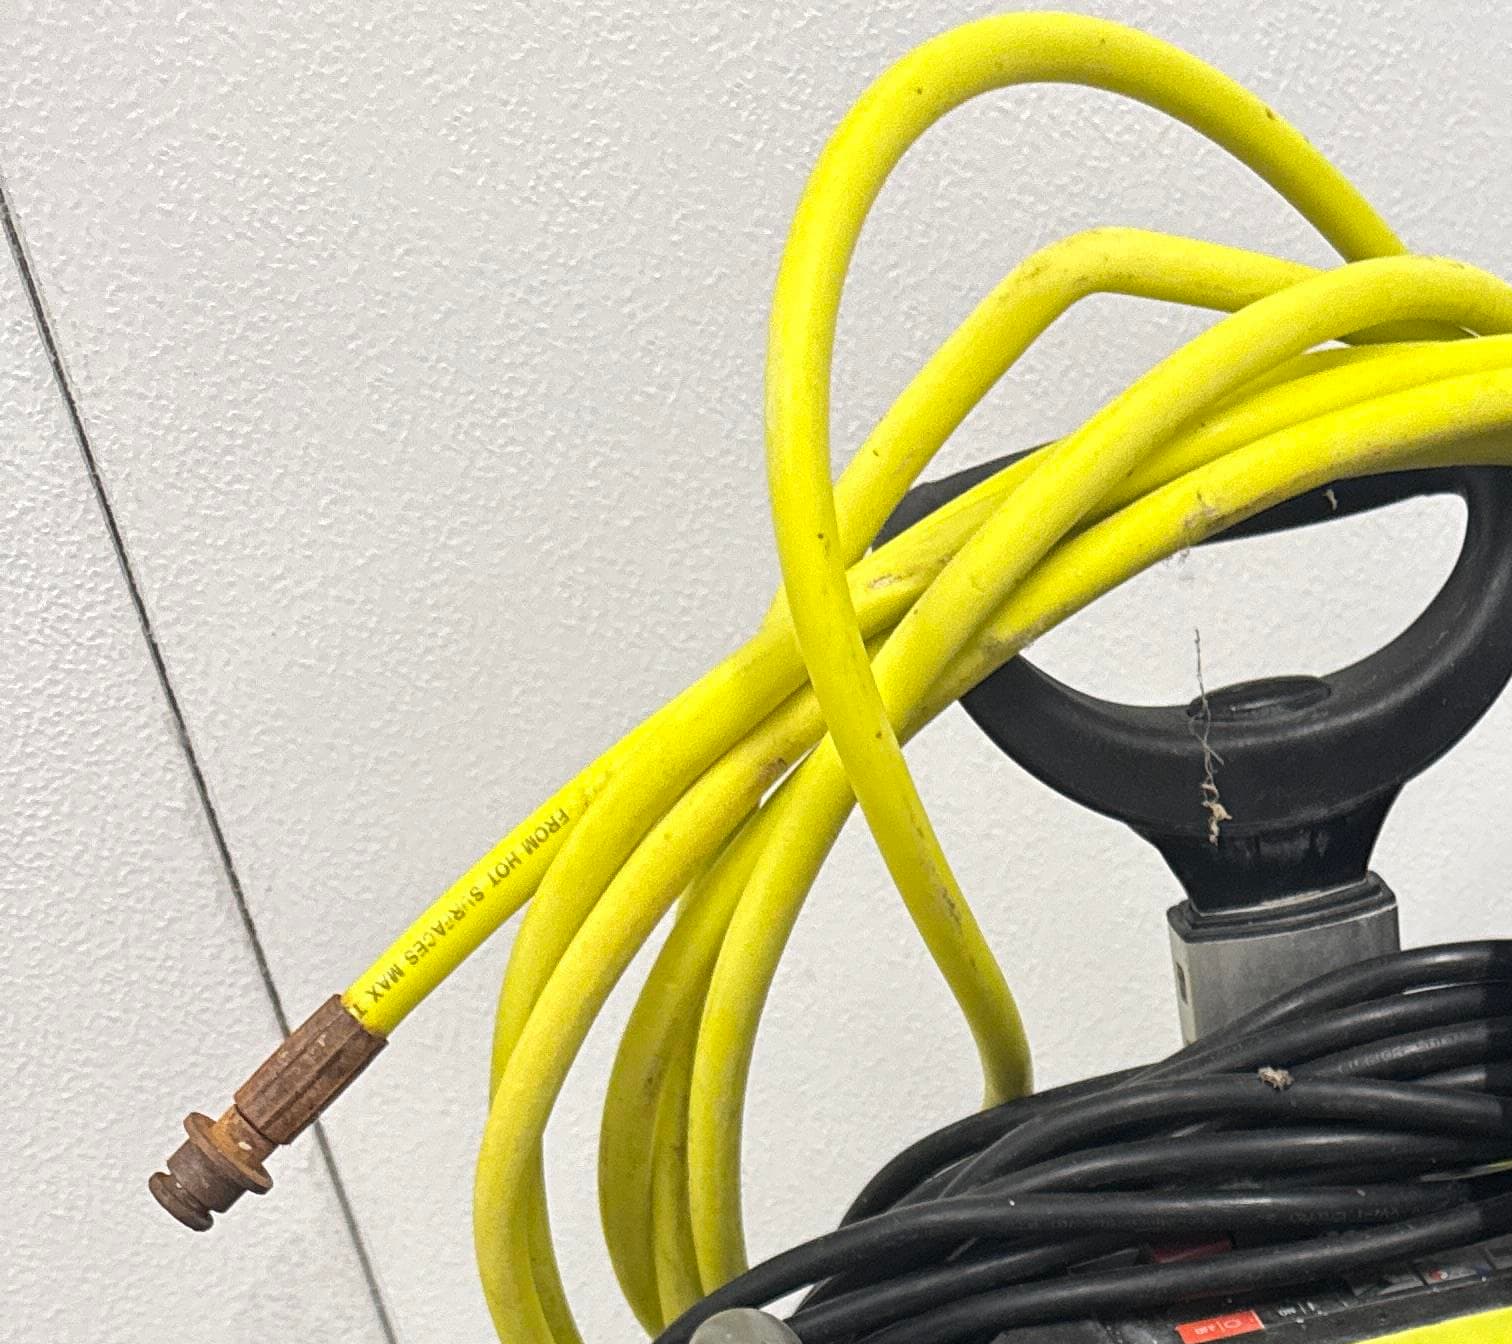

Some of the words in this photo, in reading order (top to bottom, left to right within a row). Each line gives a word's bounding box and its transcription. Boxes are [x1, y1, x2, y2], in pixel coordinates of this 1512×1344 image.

[521, 808, 570, 855] FROM
[487, 852, 522, 888] HOT
[365, 964, 405, 1003] MAX
